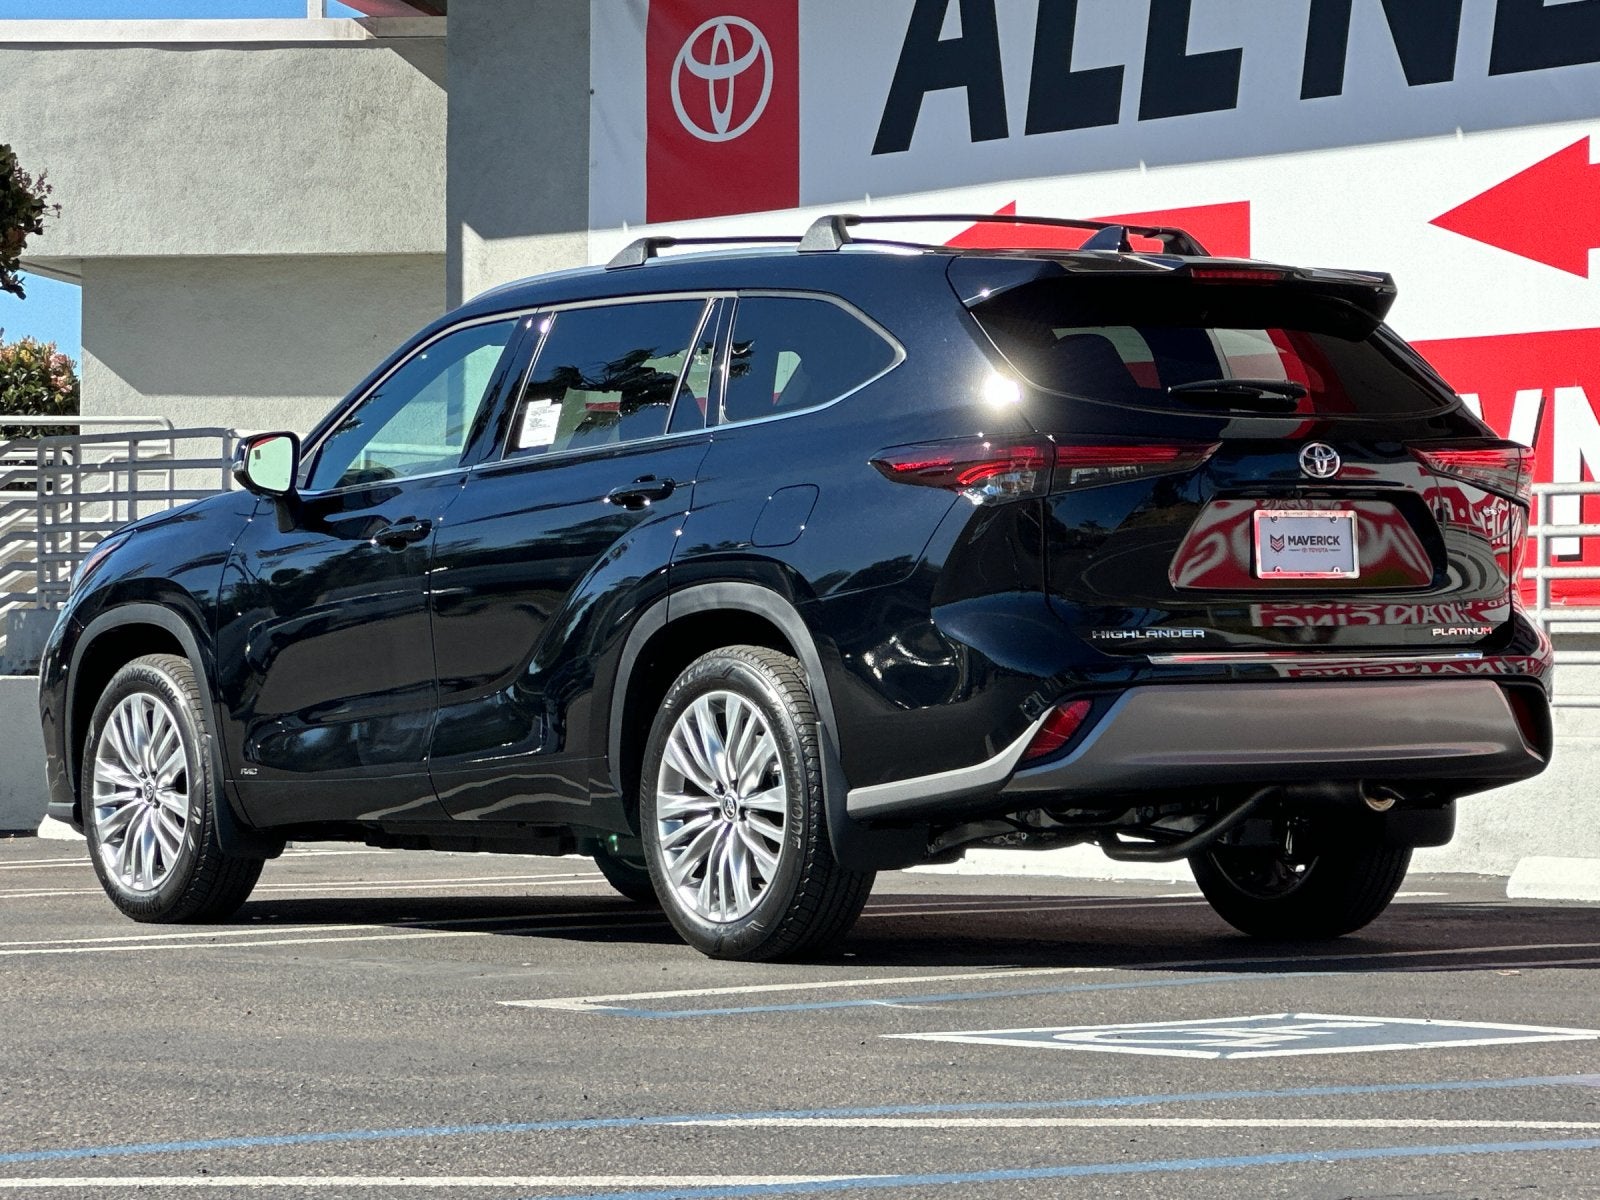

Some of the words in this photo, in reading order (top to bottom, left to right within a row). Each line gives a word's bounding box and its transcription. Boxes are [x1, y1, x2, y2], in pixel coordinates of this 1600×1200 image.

[871, 0, 1243, 156] ALL
[1287, 535, 1341, 546] MAVERICK
[1091, 629, 1206, 639] HIGHLANDER
[1432, 626, 1493, 637] PLATINUM
